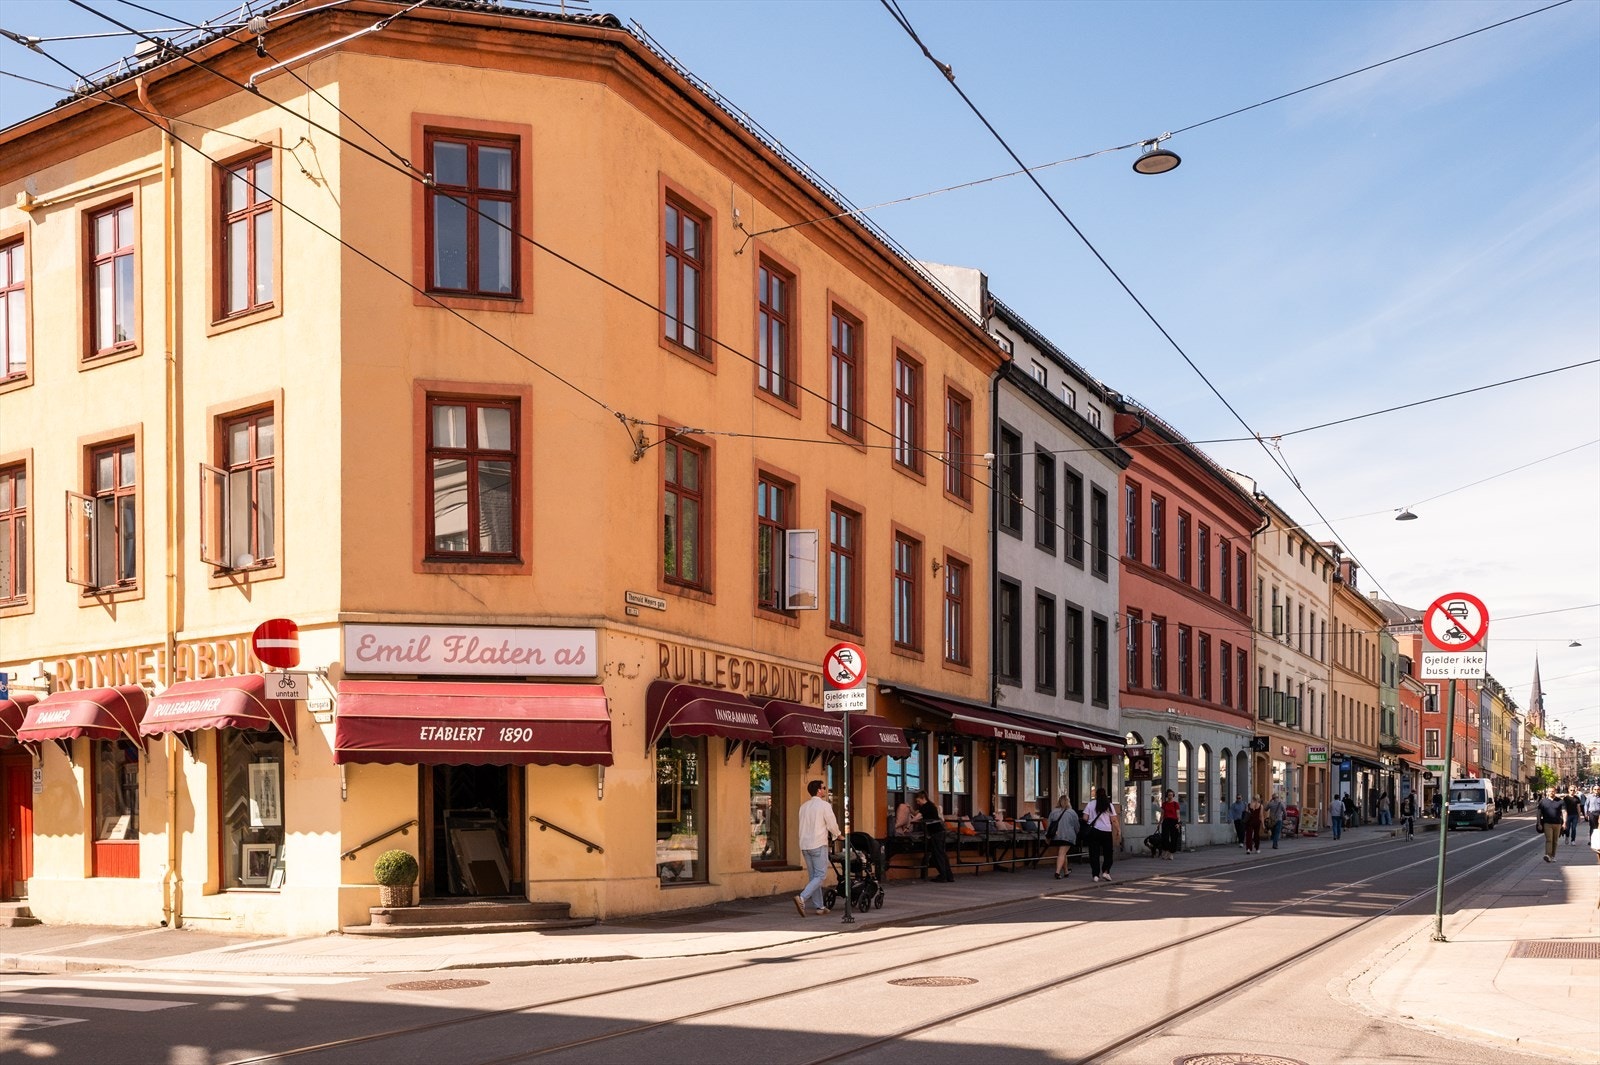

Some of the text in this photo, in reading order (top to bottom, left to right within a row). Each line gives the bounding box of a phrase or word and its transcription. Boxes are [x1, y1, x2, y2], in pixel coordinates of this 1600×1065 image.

[356, 633, 586, 666] Emil Flaten as
[1424, 656, 1483, 666] Gjelder ikke
[1426, 667, 1480, 675] buss i rute
[825, 693, 849, 702] Gjelder
[153, 698, 221, 717] RULLEGARDINER
[35, 709, 71, 724] RAMMER
[715, 709, 759, 725] INNRAMMING
[420, 726, 533, 743] ETABLERT 1890
[802, 721, 844, 737] RULLEGARDINER
[879, 733, 901, 744] RAMMER
